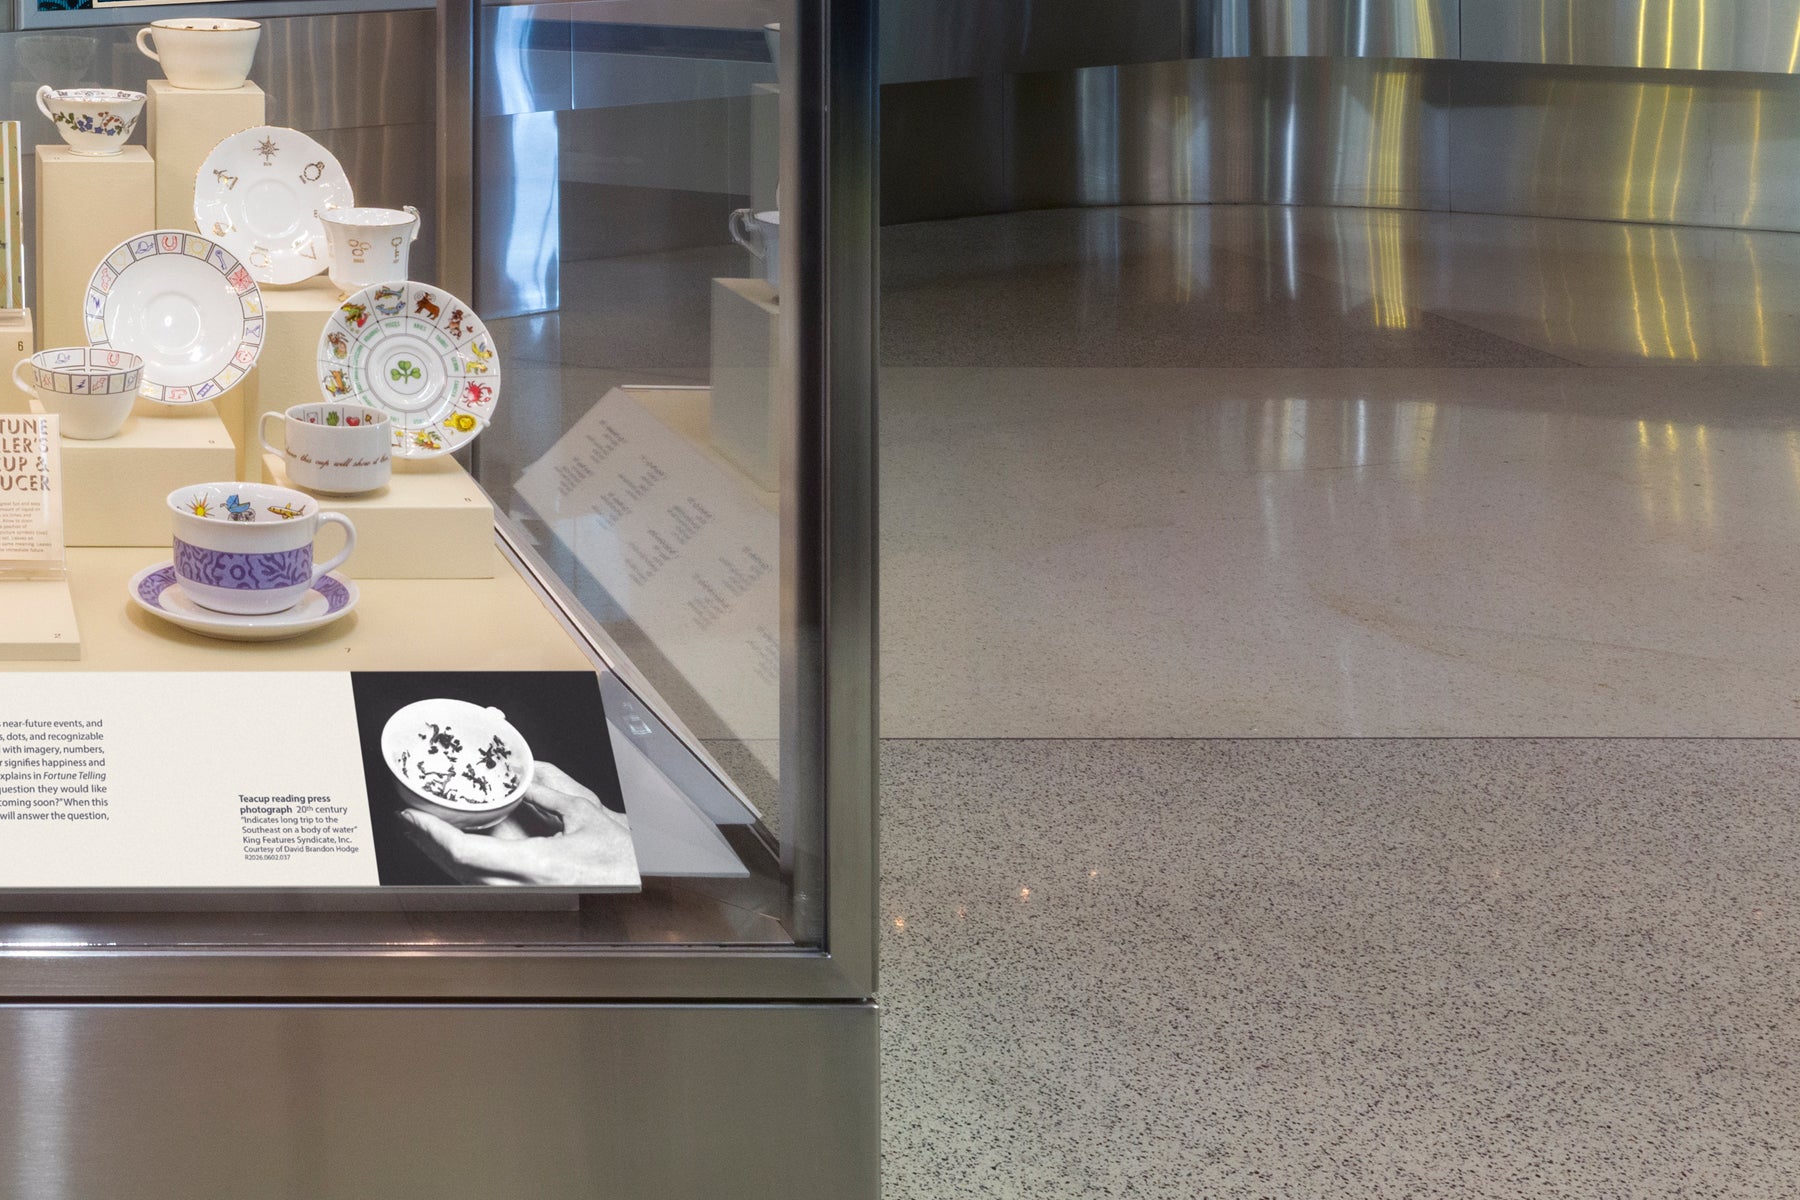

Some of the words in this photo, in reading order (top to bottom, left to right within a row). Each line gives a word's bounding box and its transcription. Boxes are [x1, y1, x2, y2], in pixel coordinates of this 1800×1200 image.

[17, 341, 24, 352] 6
[36, 456, 50, 473] &
[300, 454, 312, 464] this
[334, 458, 351, 467] will
[238, 794, 271, 805] Teacup
[271, 794, 306, 805] reading
[306, 796, 331, 805] press
[239, 805, 293, 816] photograph
[314, 805, 348, 816] century
[280, 815, 299, 826] long
[299, 815, 314, 825] trip
[314, 816, 324, 824] to
[324, 815, 339, 824] the
[241, 826, 281, 834] Southeast
[300, 825, 322, 836] body
[322, 825, 331, 834] of
[242, 836, 261, 846] King
[262, 835, 296, 844] Features
[296, 835, 337, 845] Syndicate,
[337, 835, 353, 844] Inc.
[243, 845, 275, 854] Courtesy
[275, 845, 283, 853] of
[283, 845, 305, 853] David
[304, 845, 335, 853] Brandon
[335, 845, 359, 854] Hodge
